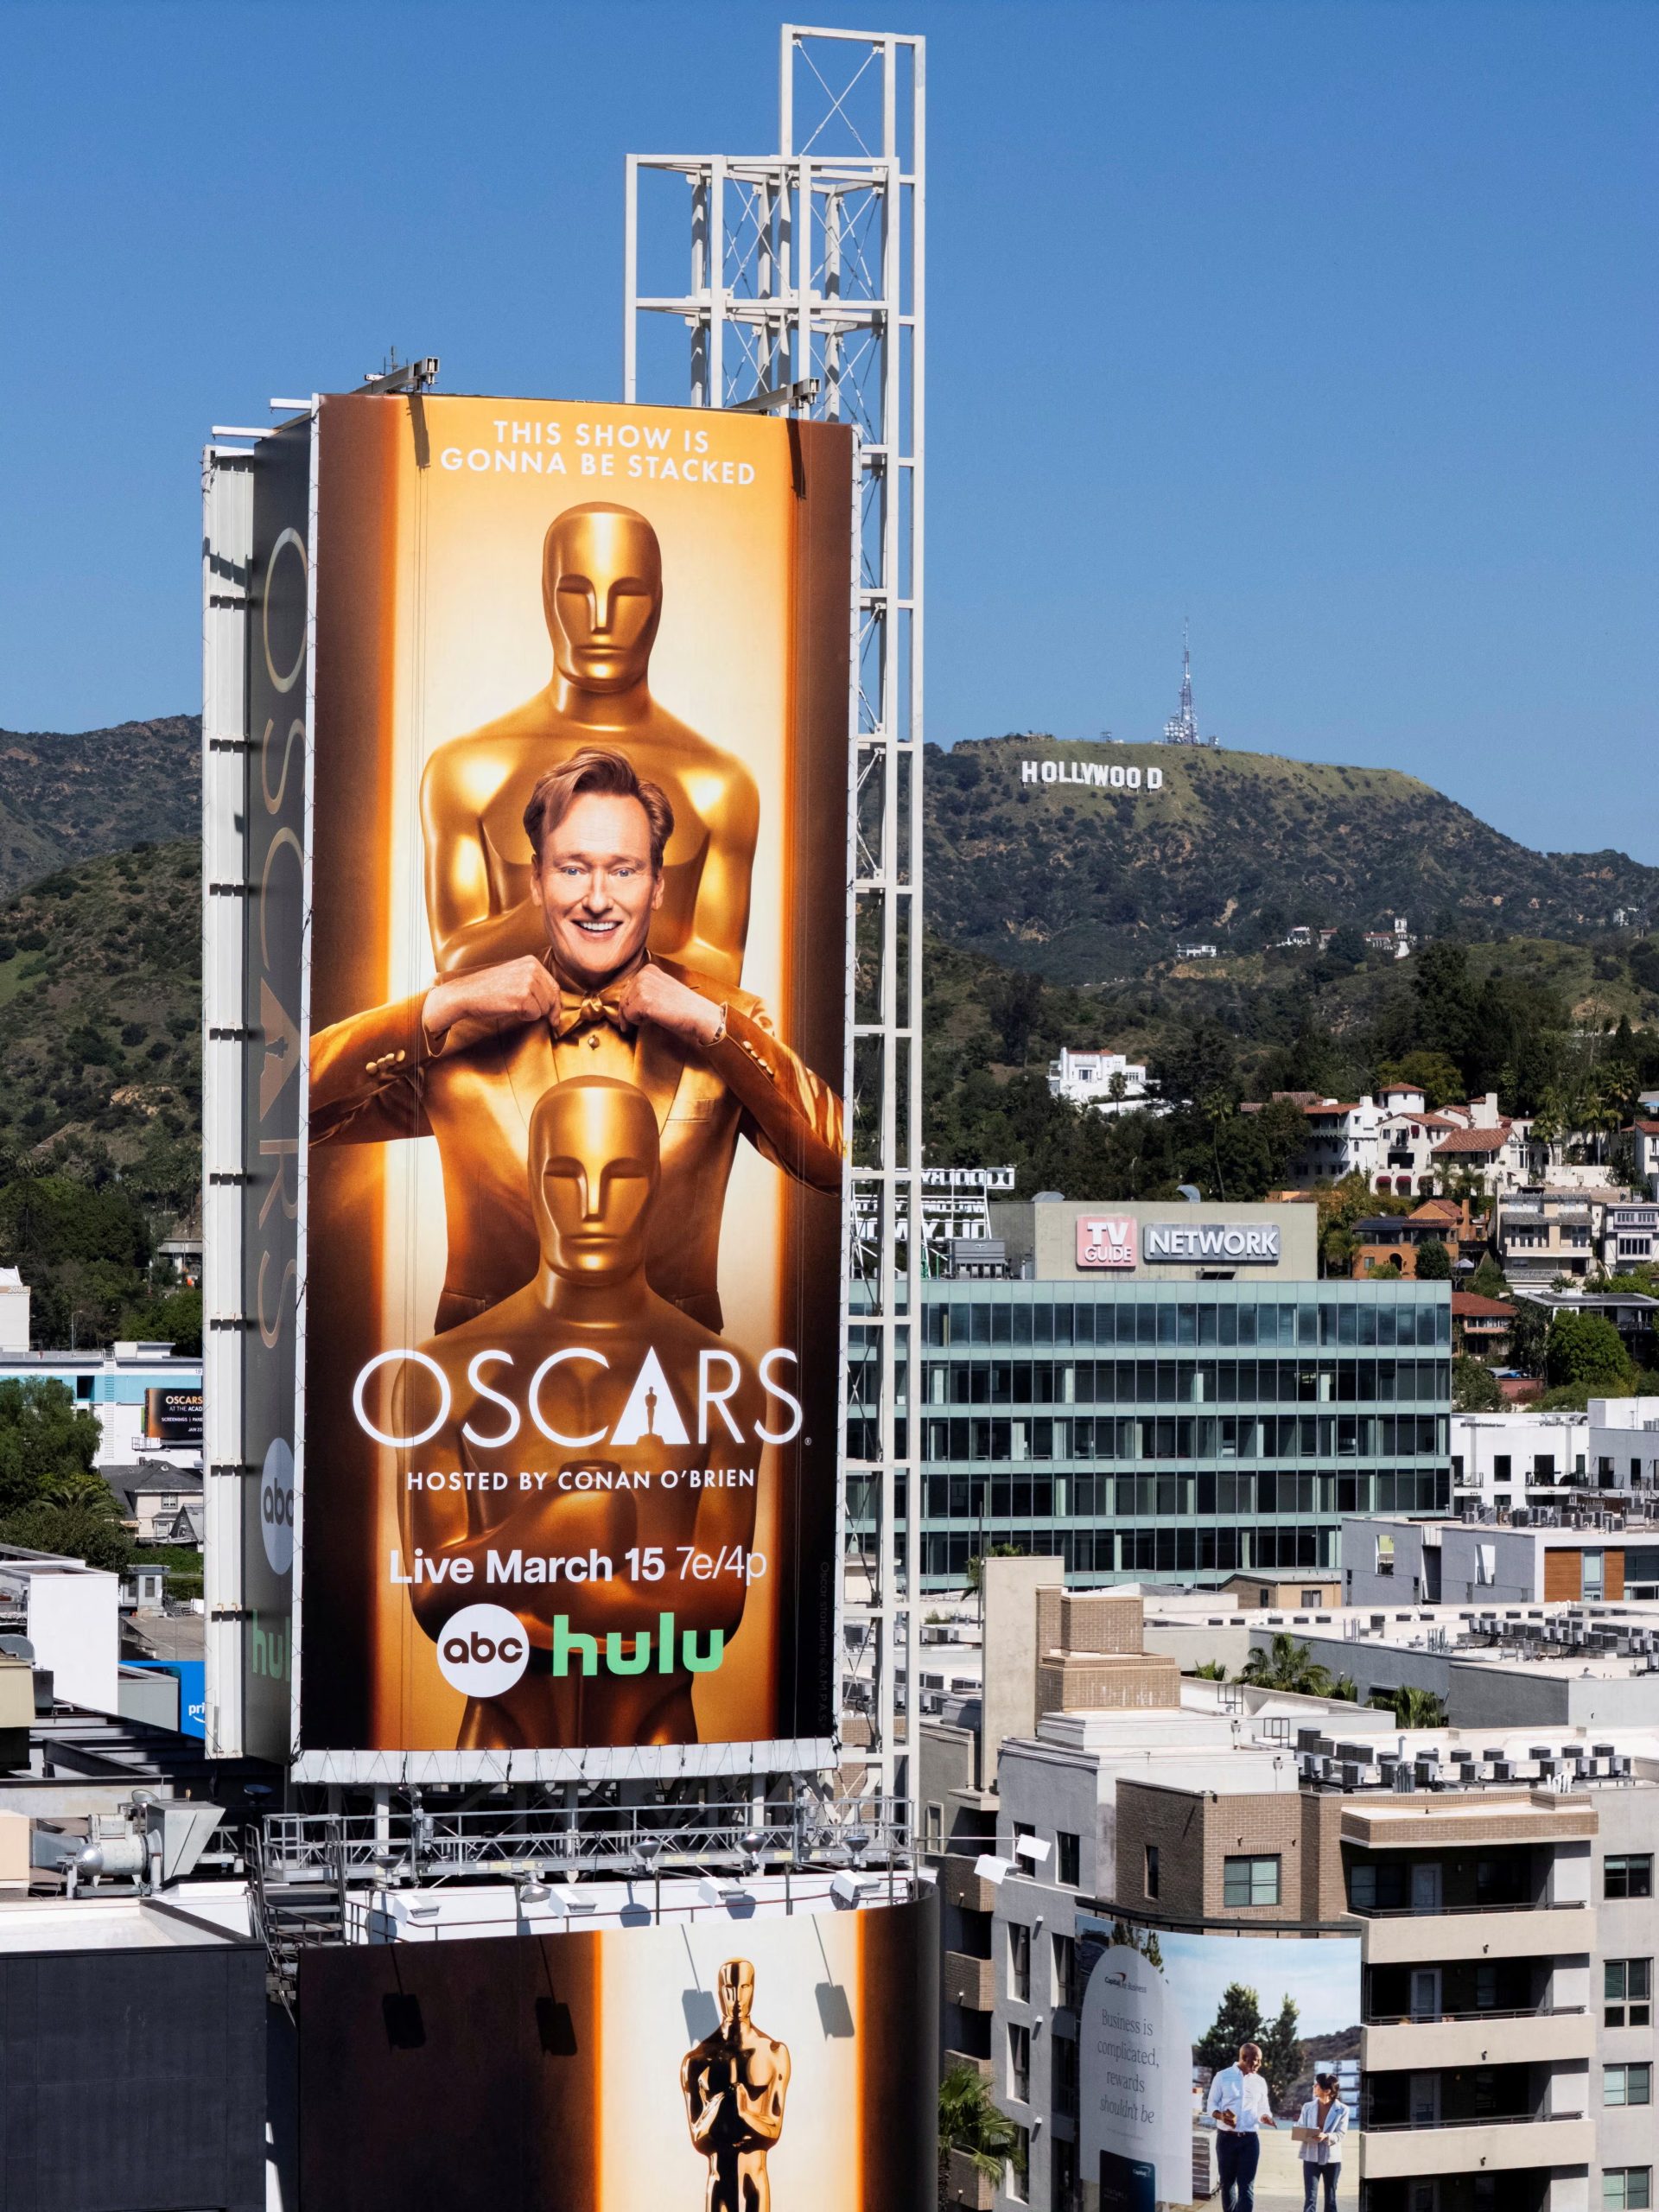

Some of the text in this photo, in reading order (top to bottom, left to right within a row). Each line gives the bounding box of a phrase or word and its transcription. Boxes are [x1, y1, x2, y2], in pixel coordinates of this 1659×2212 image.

[493, 421, 709, 454] THIS SHOW IS
[441, 448, 755, 485] GONNA BE STACKED
[1021, 760, 1163, 790] HOLLYWOOD
[1087, 1222, 1128, 1246] TV
[1149, 1230, 1279, 1255] NETWORK
[1084, 1246, 1132, 1262] GUIDE
[165, 1395, 203, 1404] OSCARS
[352, 1345, 803, 1447] OSCARS
[407, 1469, 754, 1491] HOSTED BY CONAN O’BRIEN
[390, 1545, 767, 1585] Live March 15 7e/4p
[252, 1609, 291, 1682] hul
[443, 1612, 724, 1677] abc hulu
[188, 1701, 205, 1716] pri
[1102, 2008, 1154, 2036] Business is
[1097, 2040, 1160, 2069] complicated,
[1107, 2071, 1145, 2093] rewards
[1141, 2105, 1154, 2124] be
